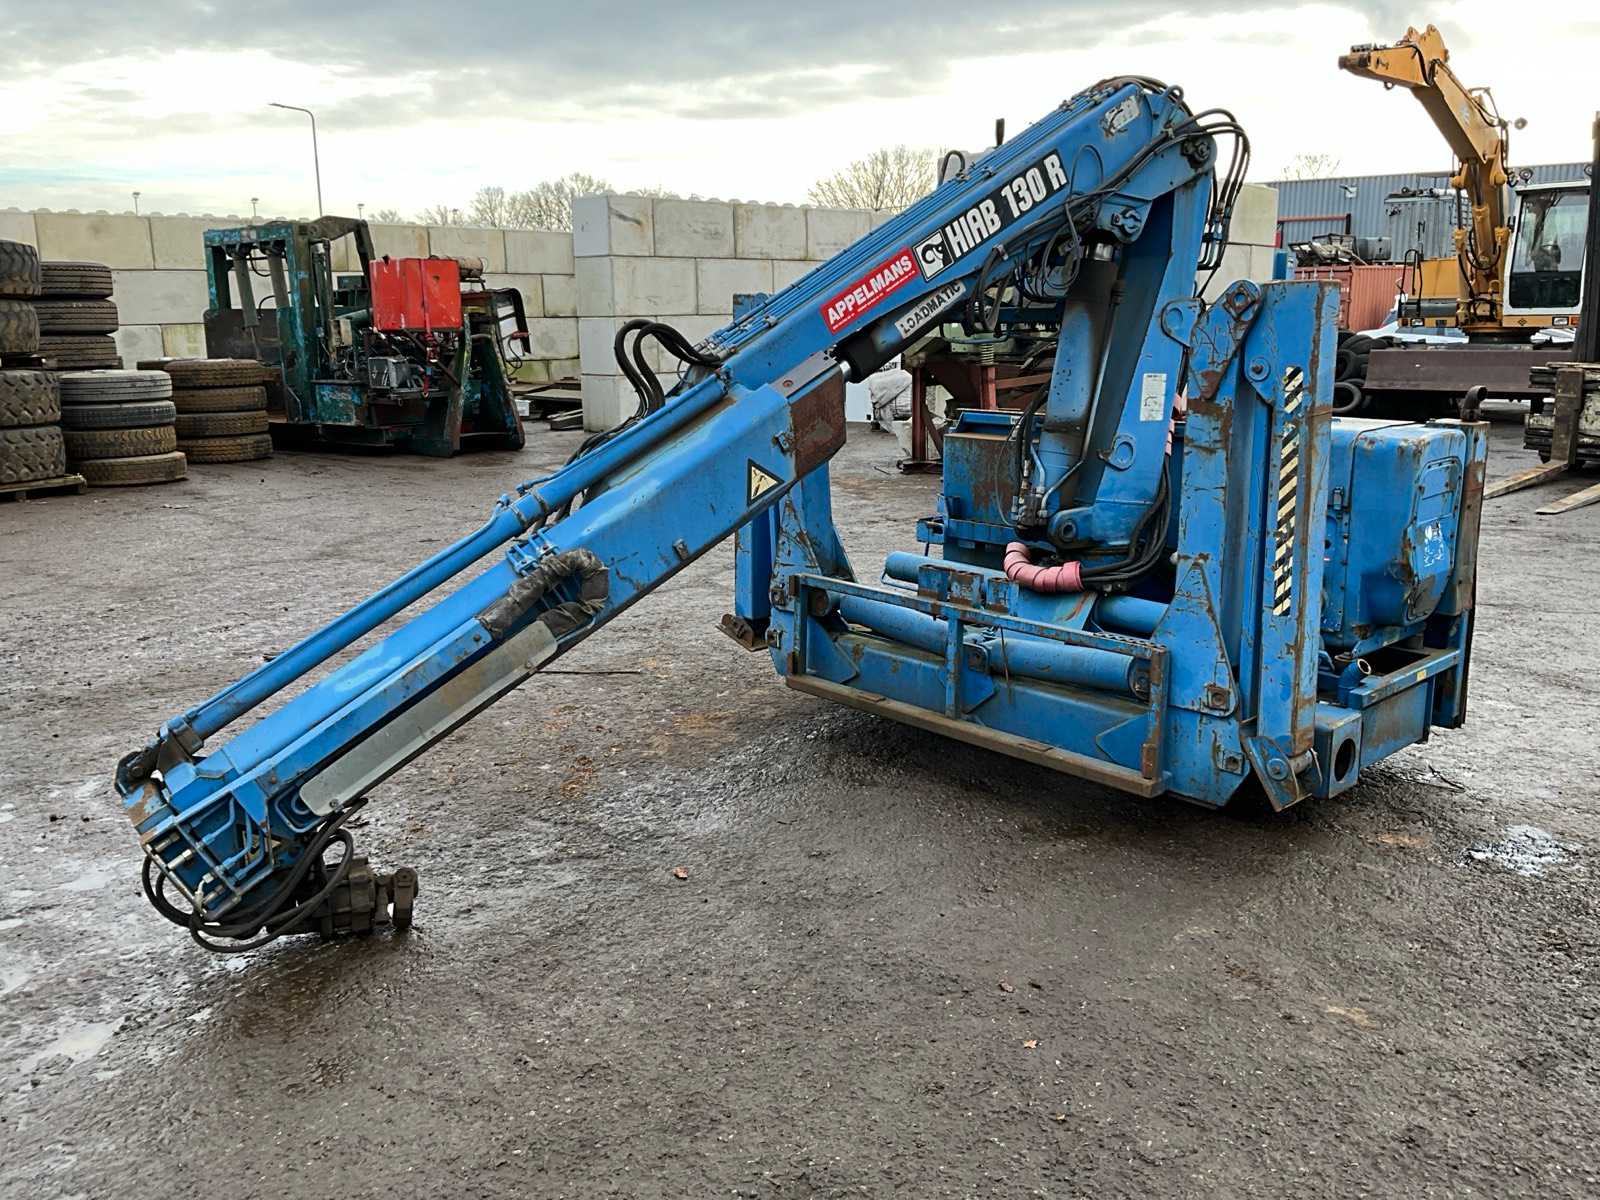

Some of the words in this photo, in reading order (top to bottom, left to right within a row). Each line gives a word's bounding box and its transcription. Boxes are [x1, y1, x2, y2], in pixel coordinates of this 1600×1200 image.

[945, 199, 1002, 258] HIAB
[1001, 167, 1047, 218] 130
[1044, 154, 1067, 190] R
[827, 255, 913, 325] APPELMANS
[900, 280, 961, 334] LOADMATIC
